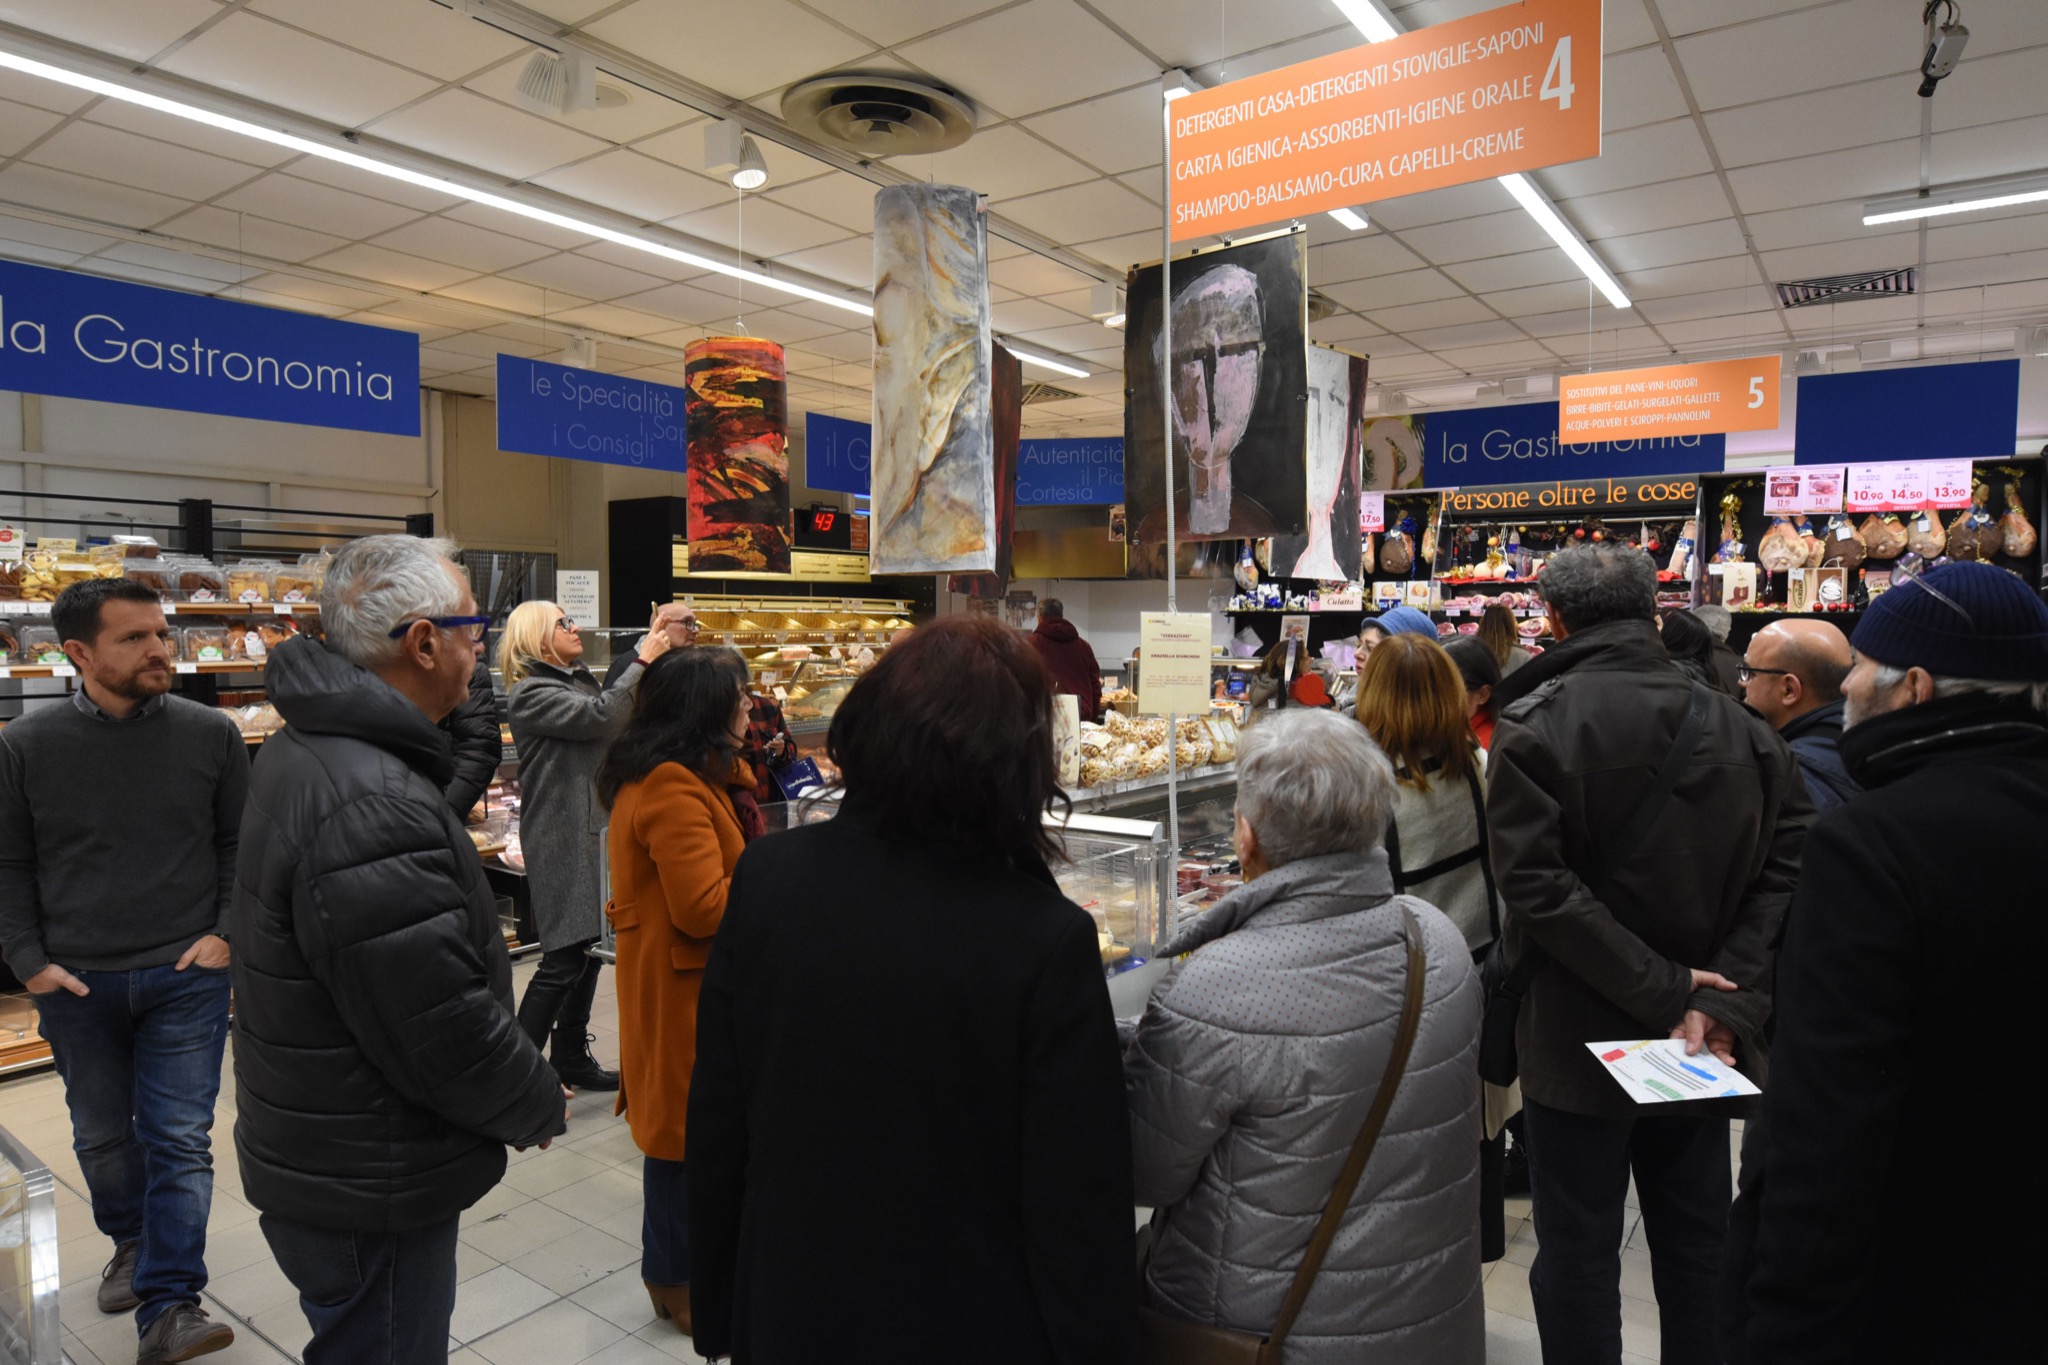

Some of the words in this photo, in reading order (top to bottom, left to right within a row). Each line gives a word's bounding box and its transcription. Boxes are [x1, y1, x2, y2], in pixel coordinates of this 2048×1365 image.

[1176, 100, 1254, 139] DETERGENTI
[1257, 63, 1388, 117] CASA-DETERGENTI
[1392, 21, 1543, 82] STOVIGLIE-SAPONI
[1539, 35, 1575, 111] 4
[1175, 153, 1223, 181] CARTA
[1227, 91, 1466, 169] IGIENICA-ASSORBENTI-IGIENE
[1472, 75, 1533, 110] ORALE
[1176, 160, 1384, 224] SHAMPOO-BALSAMO-CURA
[1389, 127, 1525, 177] CAPELLI-CREME
[0, 295, 46, 354] la
[74, 314, 393, 401] Gastronomia
[531, 362, 552, 397] le
[561, 371, 673, 417] Specialità
[1566, 385, 1608, 399] SOSTITUTIVI
[1609, 384, 1623, 396] DEL
[1625, 377, 1697, 395] PANE-VINI-LIQUORI
[1566, 391, 1721, 415] BIRRE-BIBITE-GELATI-SURGELATI-GALLETTE
[1747, 376, 1765, 409] 5
[1565, 416, 1622, 432] ACQUE-POLVERI
[1624, 416, 1629, 427] E
[1630, 410, 1711, 426] SCIROPPI-PANNOLINI
[567, 423, 654, 465] Consigli
[1442, 430, 1468, 464] la
[1015, 481, 1093, 502] Cortesia
[1441, 489, 1531, 511] Persone
[1538, 481, 1596, 505] oltre
[1606, 478, 1628, 504] le
[1637, 480, 1696, 502] cose
[1853, 490, 1883, 502] 10,90
[1891, 489, 1923, 500] 14,50
[1934, 486, 1966, 498] 13,90
[815, 513, 835, 532] 43
